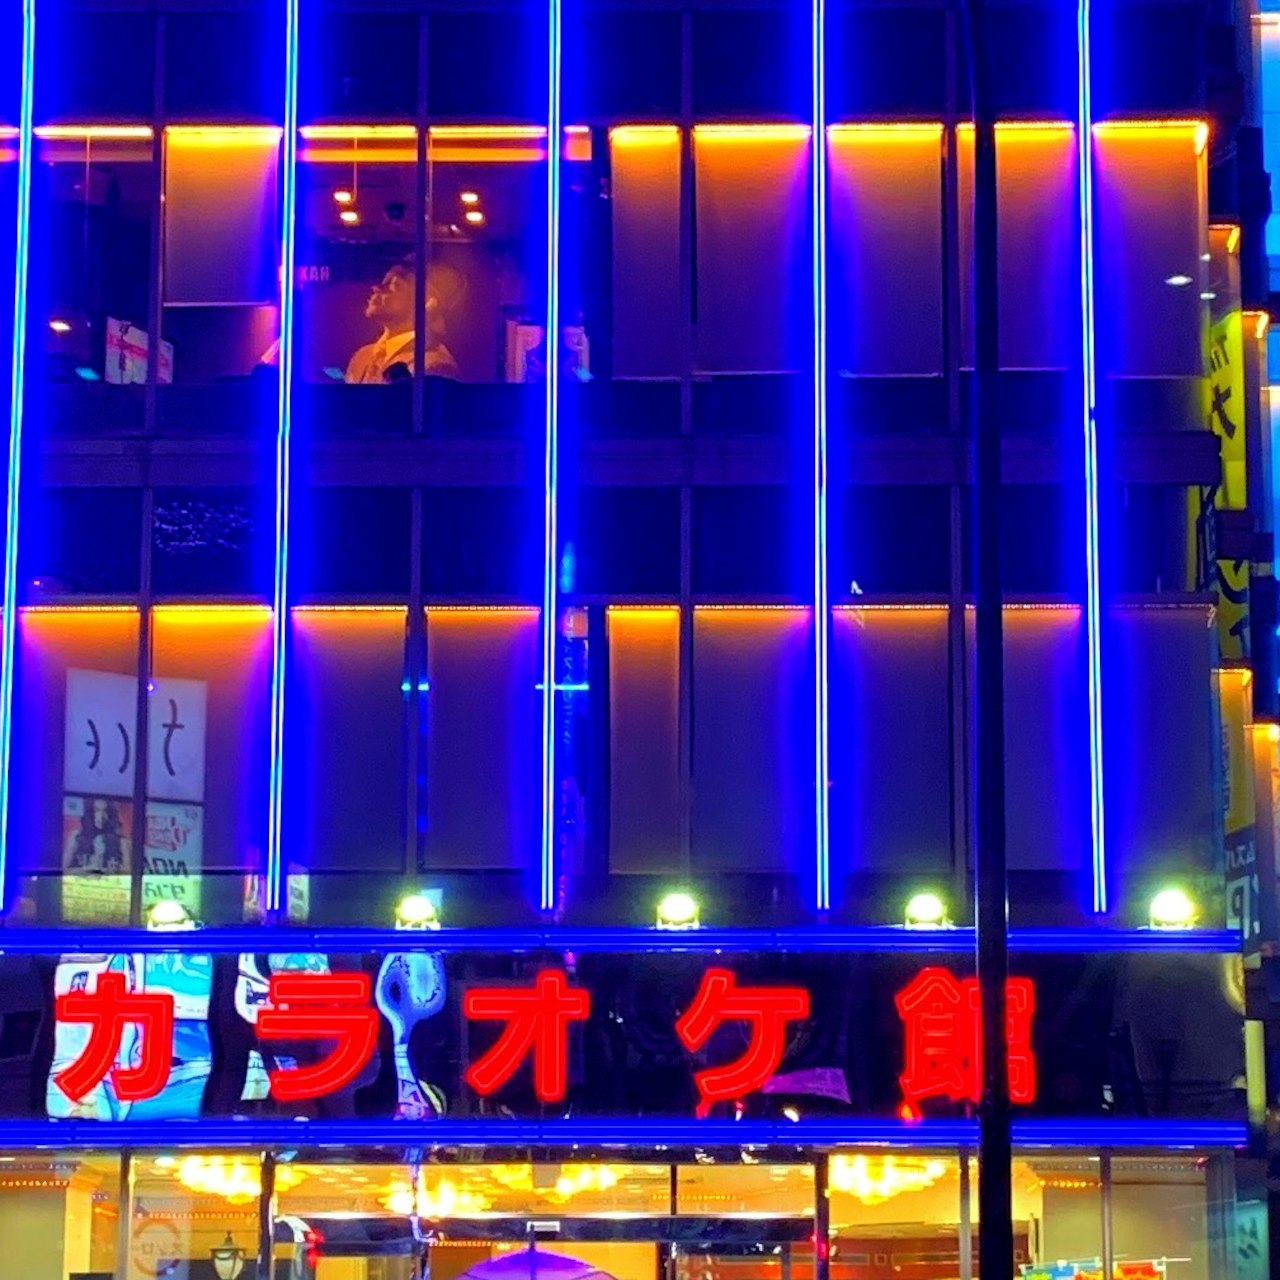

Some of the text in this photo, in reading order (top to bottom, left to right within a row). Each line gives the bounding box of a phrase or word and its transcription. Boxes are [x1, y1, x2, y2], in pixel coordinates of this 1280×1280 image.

[53, 967, 1033, 1105] カラオケ館
